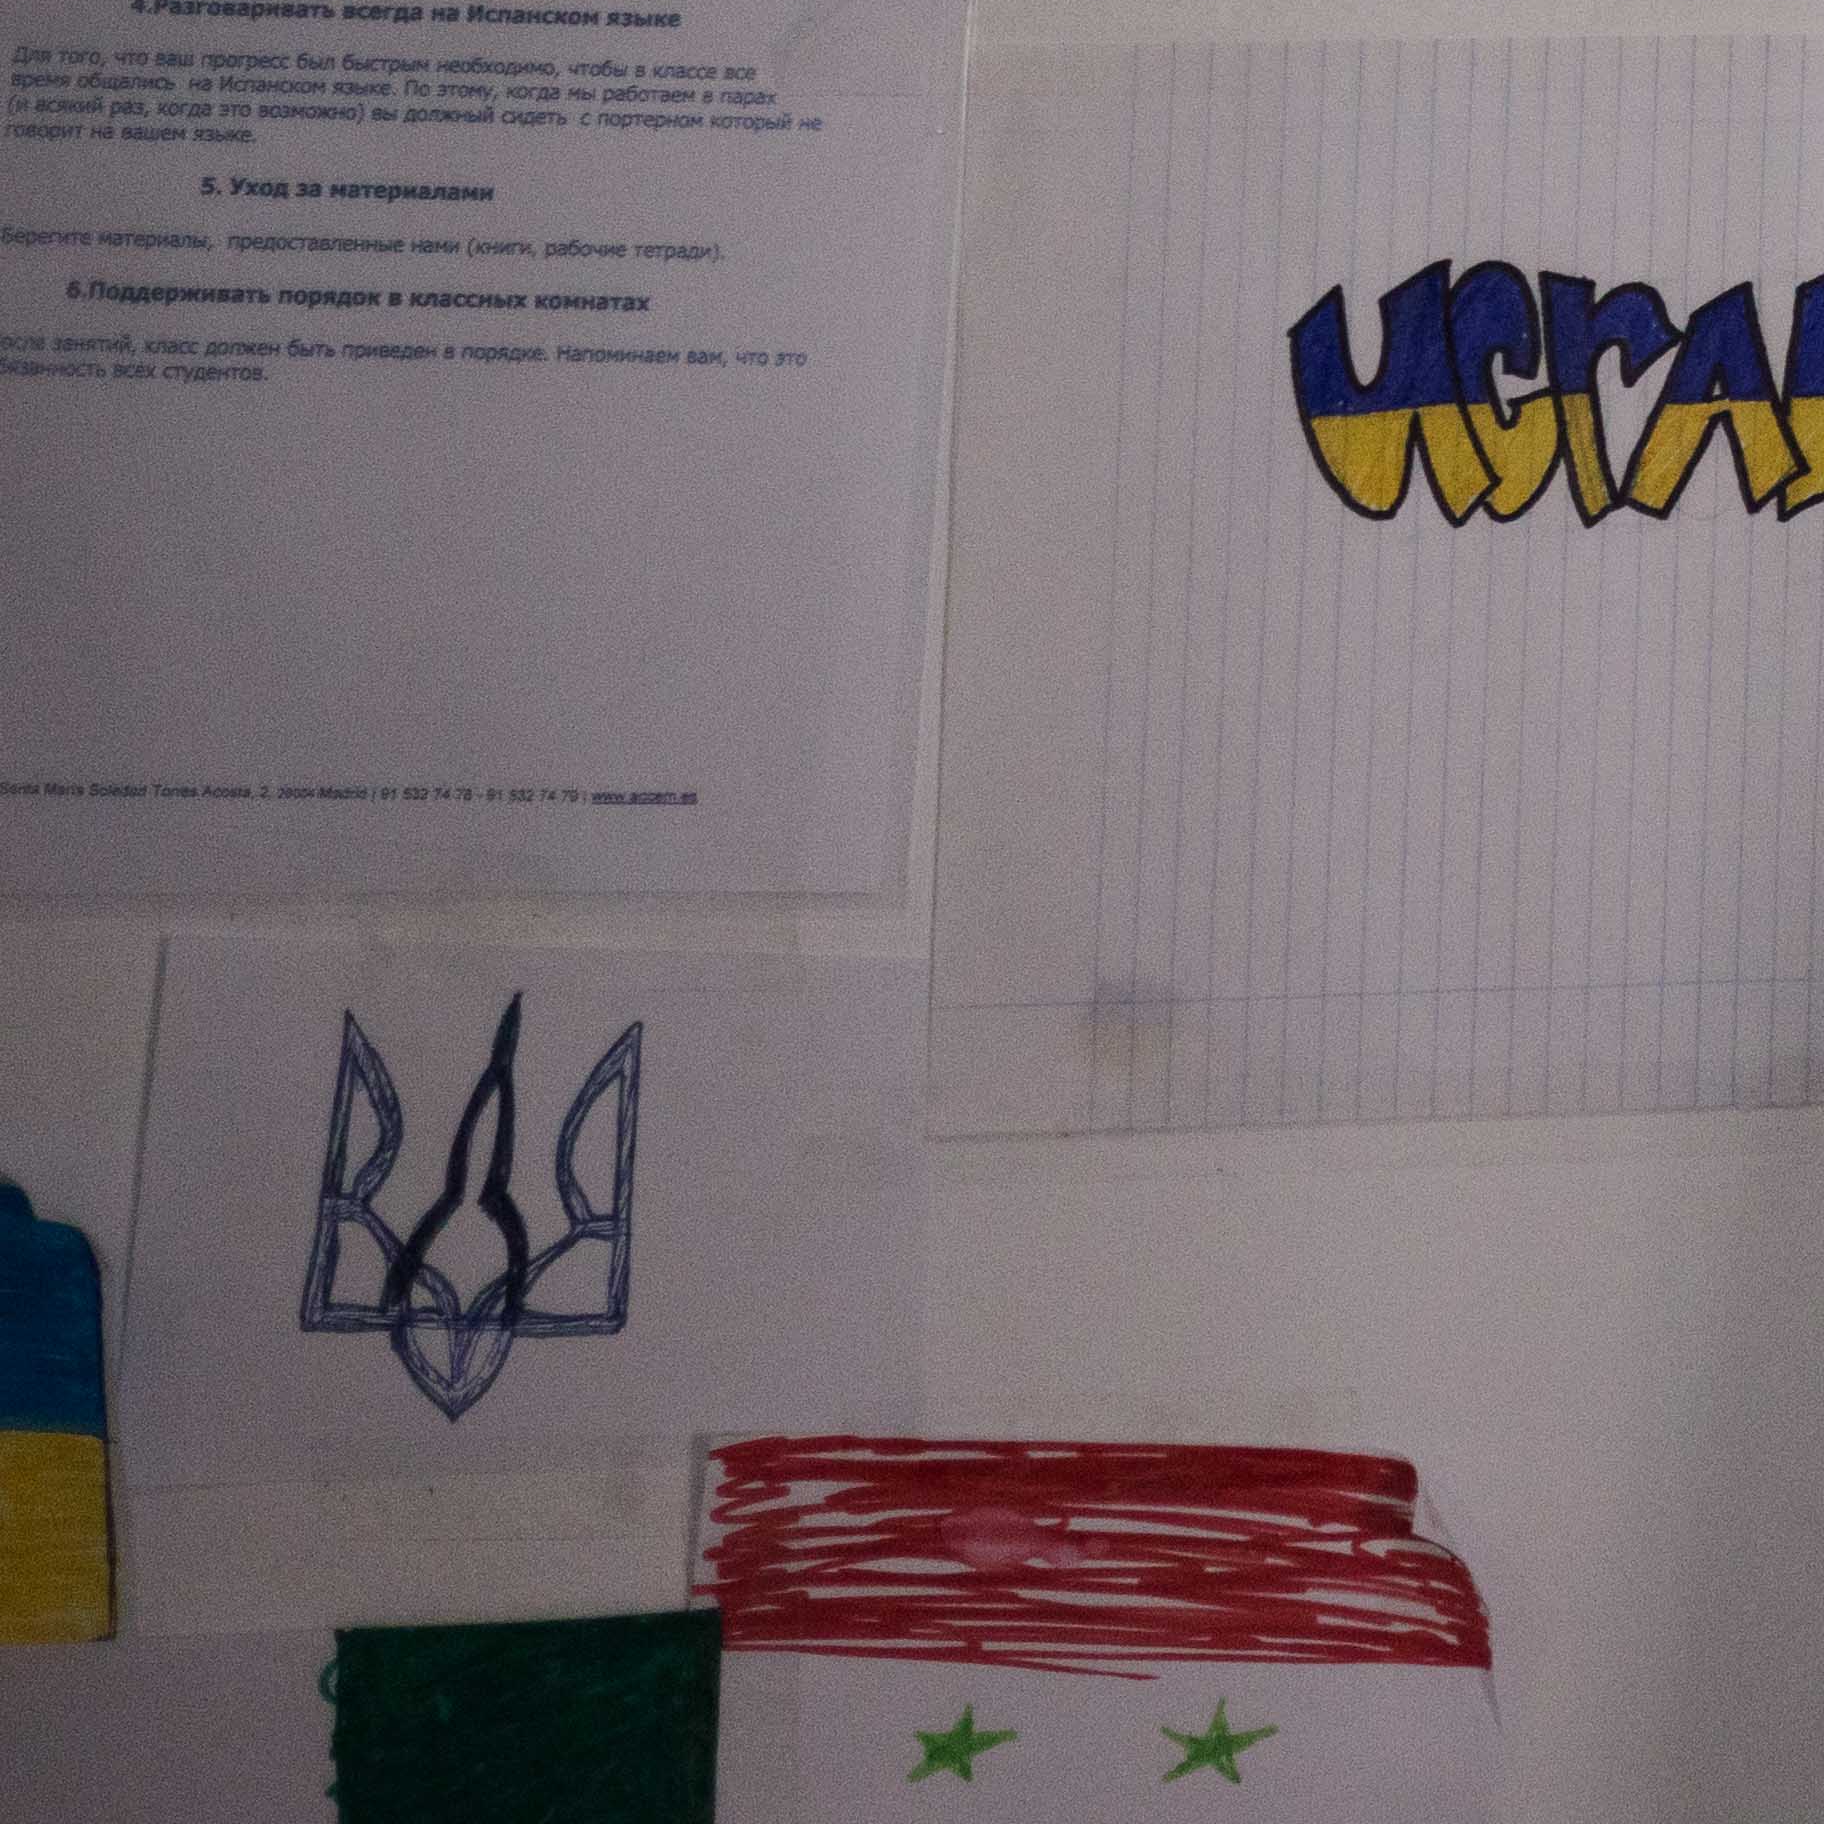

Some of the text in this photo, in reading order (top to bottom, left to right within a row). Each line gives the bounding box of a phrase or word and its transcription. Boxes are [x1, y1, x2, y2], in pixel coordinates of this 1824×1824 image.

[341, 4, 424, 25] всегда
[430, 6, 461, 23] на
[466, 4, 601, 26] Испанском
[606, 11, 681, 28] языке
[12, 45, 52, 64] Для
[60, 50, 106, 67] того,
[115, 51, 148, 67] что
[155, 52, 194, 68] ваш
[296, 52, 335, 71] был
[341, 53, 430, 77] быстрым
[436, 55, 562, 79] необходимо,
[569, 58, 628, 78] чтобы
[634, 63, 646, 79] в
[652, 64, 717, 80] классе
[724, 66, 756, 81] все
[157, 102, 213, 121] когда
[220, 103, 252, 118] это
[257, 100, 365, 124] возможно)
[370, 106, 398, 122] вы
[500, 110, 568, 129] сидеть
[579, 111, 590, 126] с
[709, 111, 793, 134] который
[798, 116, 823, 132] не
[199, 176, 495, 206] 5. Уход за материалами
[97, 232, 727, 263] материалы, предоставленные нами (книги, рабочие тетради).
[66, 281, 650, 312] 6.Поддерживать порядок в классных комнатах
[342, 344, 806, 367] приведен в порядке. Напоминаем вам, что это
